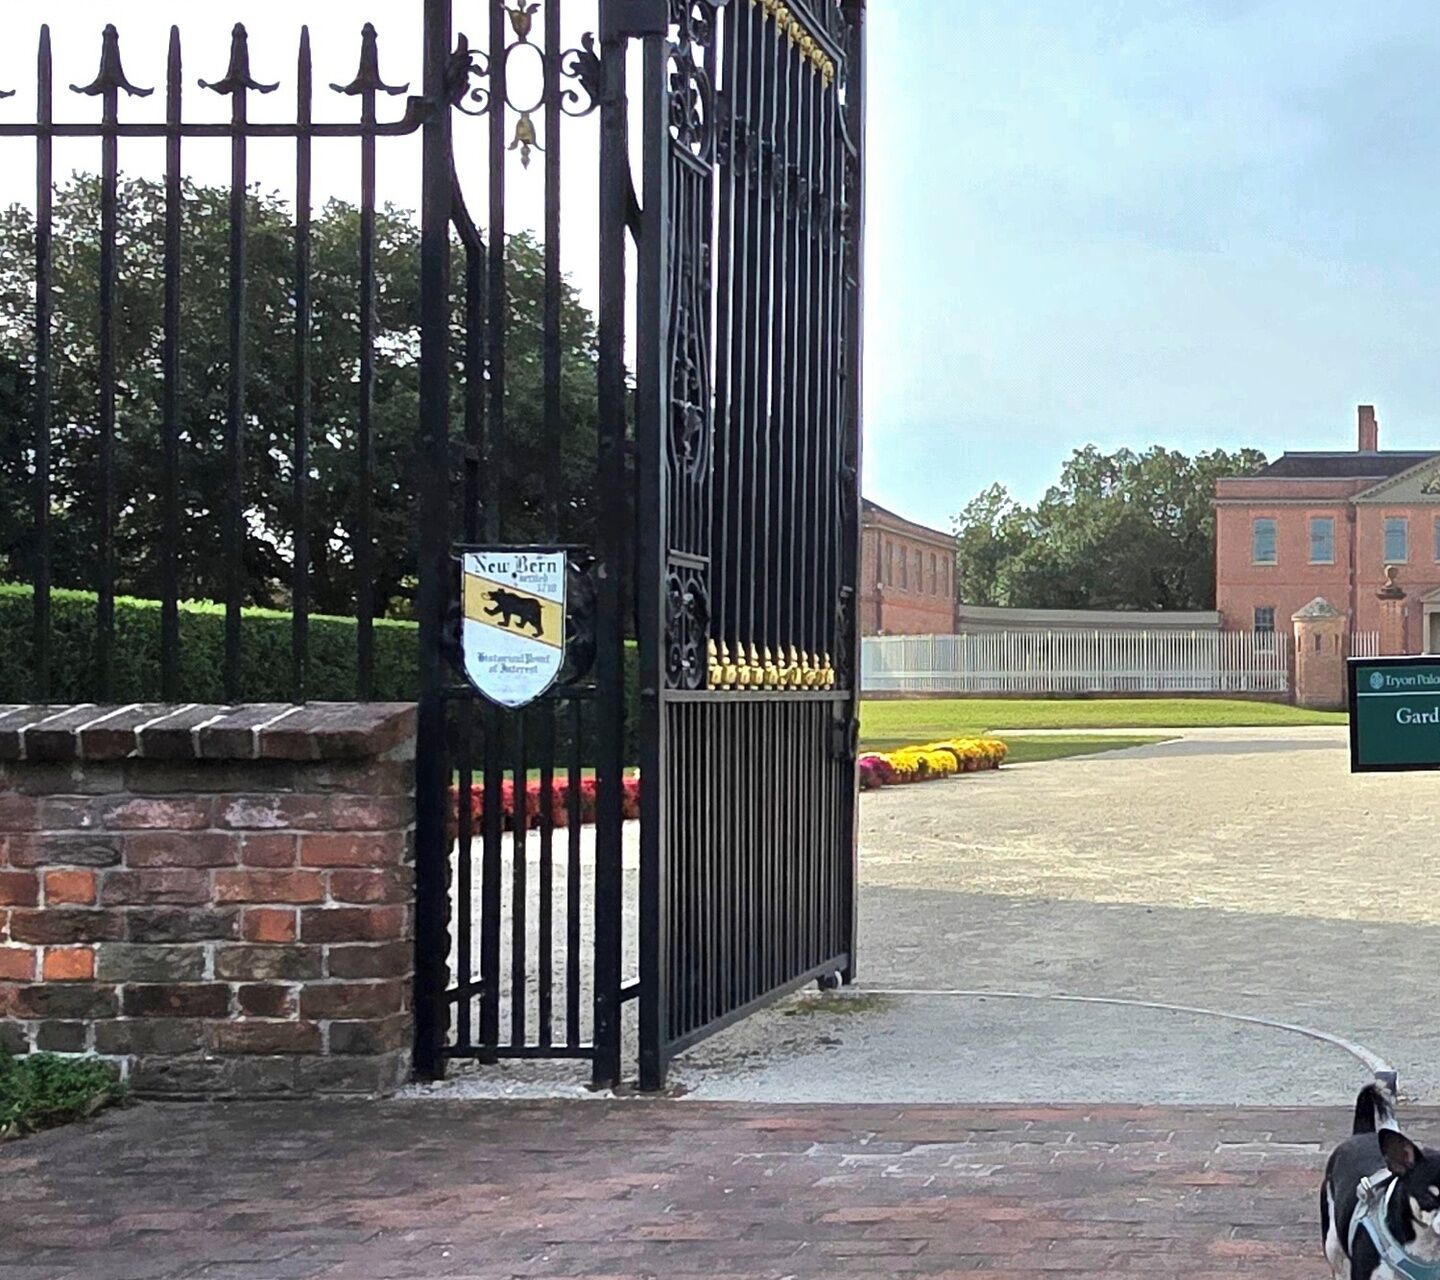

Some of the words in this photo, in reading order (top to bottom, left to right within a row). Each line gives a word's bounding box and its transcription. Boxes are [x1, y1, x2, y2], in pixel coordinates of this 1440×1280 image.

[472, 555, 510, 573] New
[515, 555, 557, 573] Bern
[1386, 675, 1416, 688] Tryon
